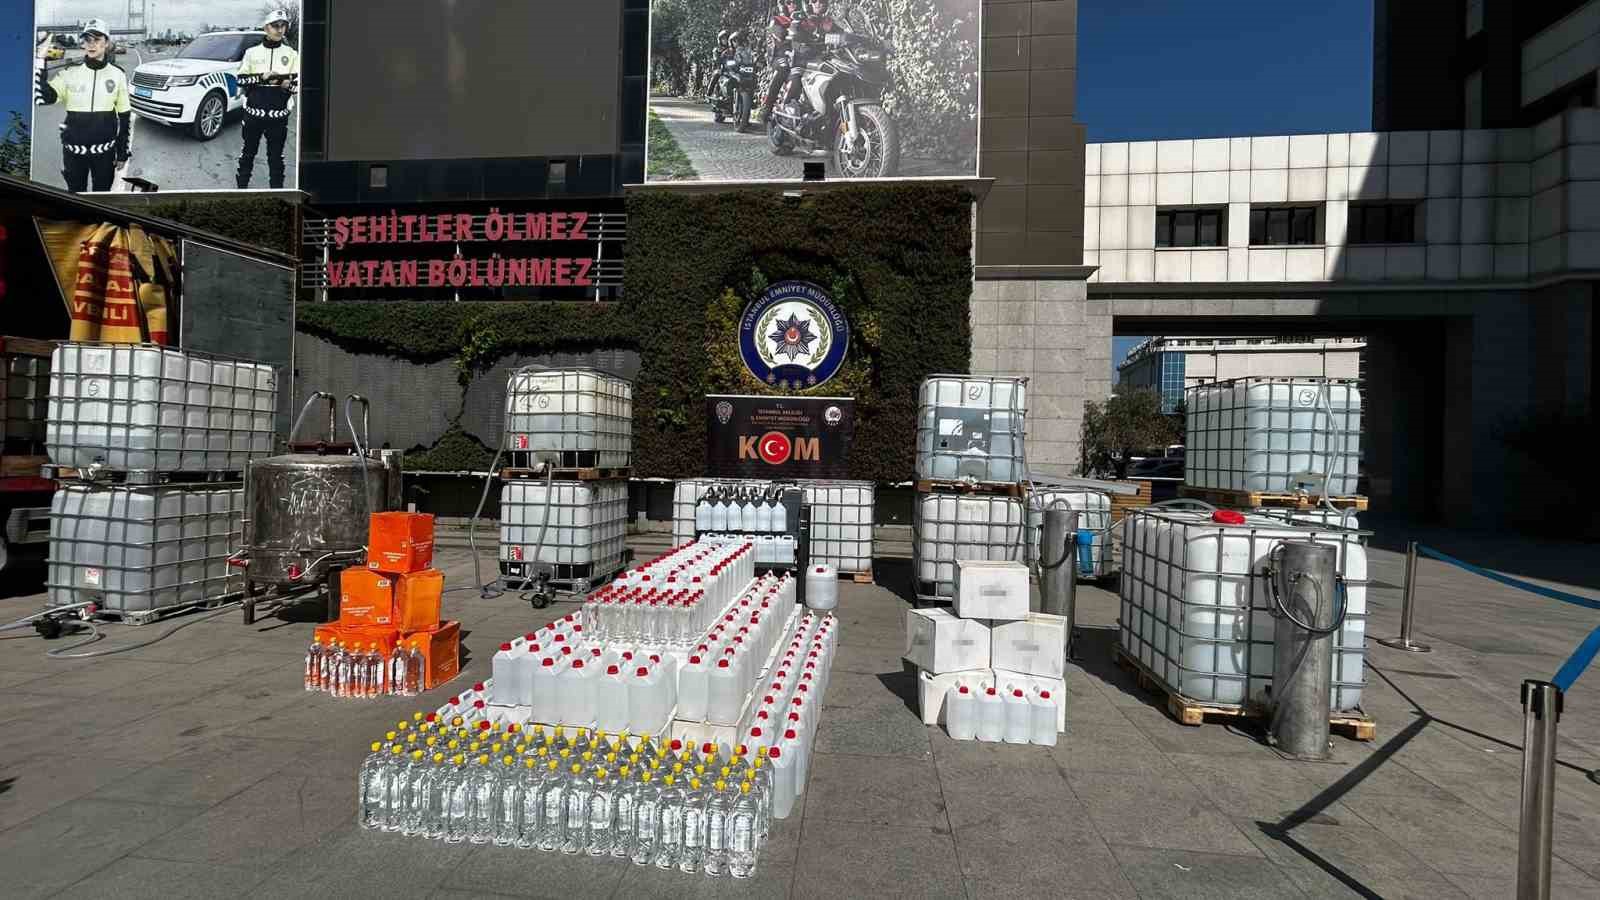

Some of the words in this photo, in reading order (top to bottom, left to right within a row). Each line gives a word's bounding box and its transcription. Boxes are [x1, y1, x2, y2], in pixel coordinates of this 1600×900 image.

[335, 208, 474, 250] ŞEHİTLER
[484, 206, 589, 241] ÖLMEZ
[327, 260, 418, 288] VATAN
[428, 252, 593, 288] BÖLÜNMEZ
